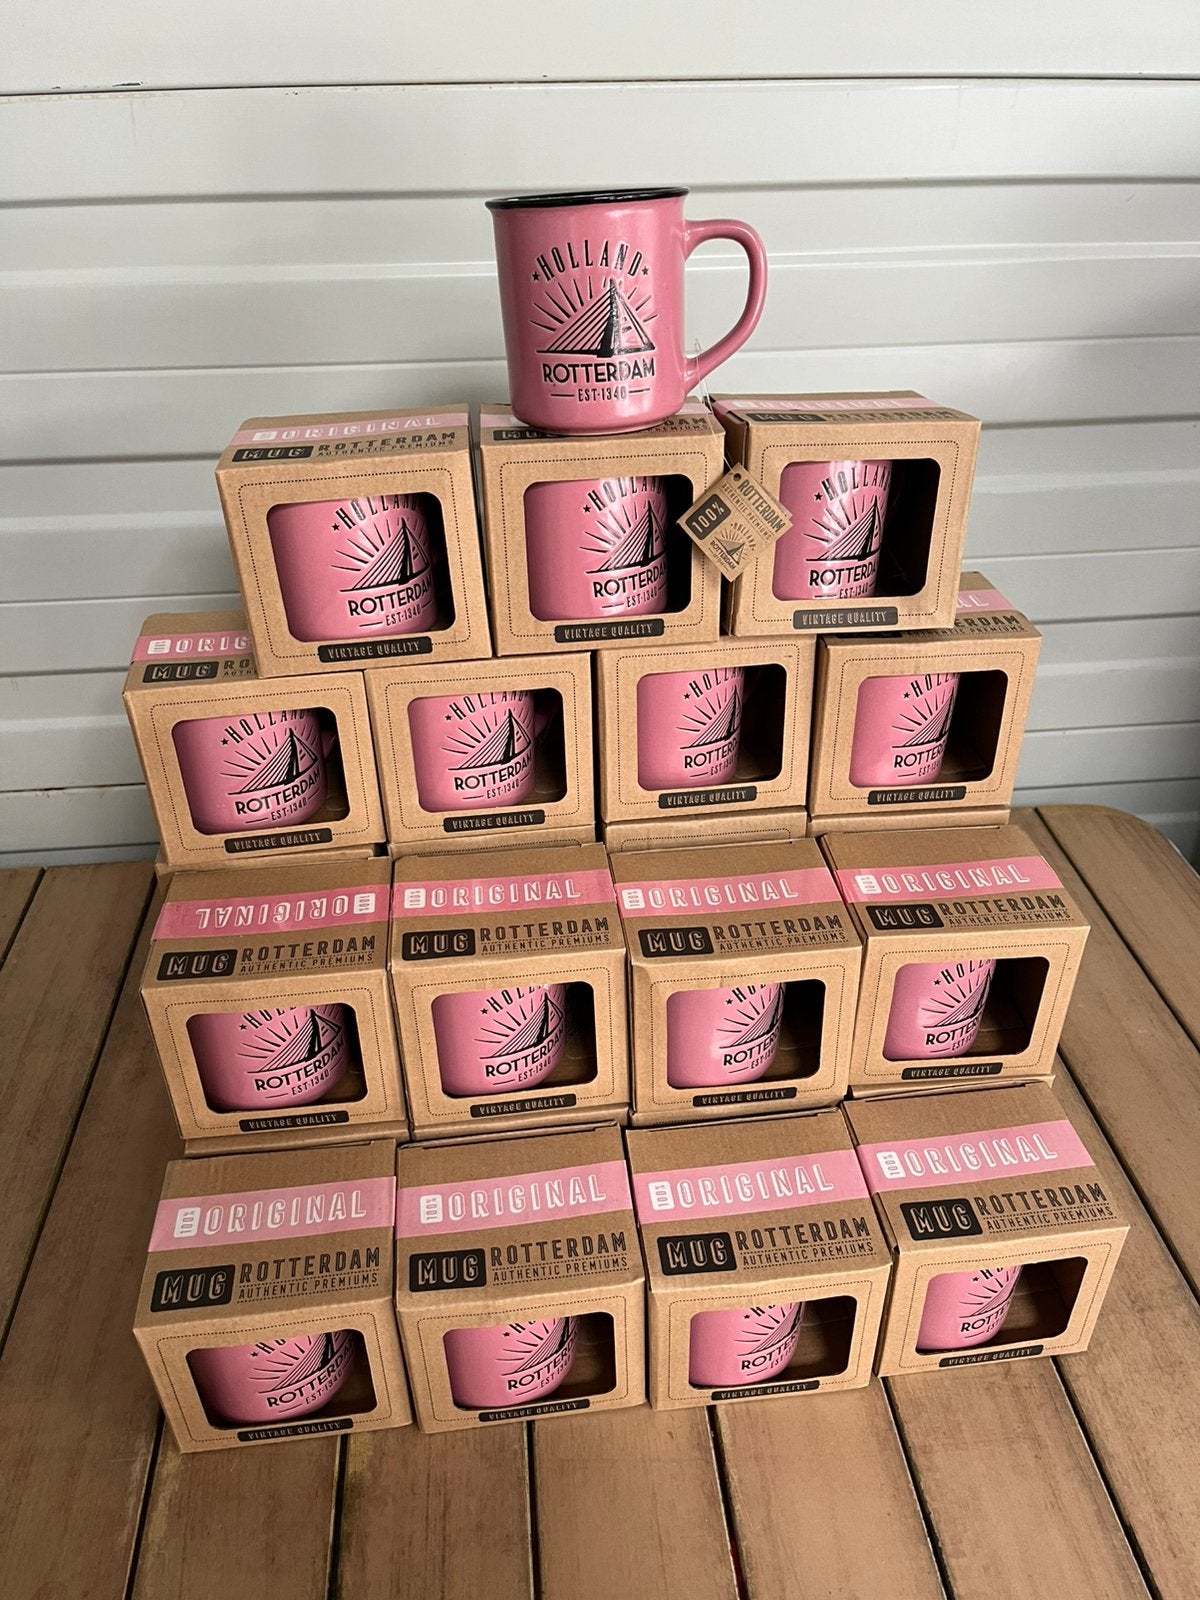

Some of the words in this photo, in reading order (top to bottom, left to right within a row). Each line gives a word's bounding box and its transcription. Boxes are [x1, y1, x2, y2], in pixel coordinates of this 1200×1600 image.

[536, 240, 643, 282] HOLLAND
[543, 358, 655, 382] ROTTERDAM
[282, 416, 441, 440] ORIGINAL
[242, 448, 305, 460] MUG
[318, 432, 456, 451] ROTTERDAM
[722, 483, 748, 512] AUTHENTIC
[738, 480, 785, 533] ROTTERDAM
[692, 501, 724, 533] 100%
[710, 540, 736, 570] ROTTERDAM
[564, 626, 607, 639] VINTAGE
[611, 624, 653, 636] QUALITY
[802, 613, 843, 625] VINTAGE
[847, 611, 887, 623] QUALITY
[328, 644, 373, 659] VINTAGE
[377, 641, 420, 656] QUALITY
[152, 665, 211, 679] MUG
[235, 769, 321, 816] ROTTERDAM
[667, 795, 706, 805] VINTAGE
[709, 791, 746, 801] QUALITY
[877, 792, 915, 802] VINTAGE
[919, 790, 955, 800] QUALITY
[452, 817, 493, 829] VINTAGE
[496, 814, 534, 825] QUALITY
[234, 835, 278, 850] VINTAGE
[281, 832, 321, 845] QUALITY
[648, 878, 799, 908] ORIGINAL
[881, 864, 1030, 894] ORIGINAL
[431, 879, 581, 908] ORIGINAL
[195, 895, 350, 929] ORIGINAL
[875, 907, 936, 927] MUG
[938, 894, 1066, 916] ROTTERDAM
[948, 913, 1010, 925] AUTHENTIC
[1013, 910, 1071, 921] PREMIUMS
[411, 933, 469, 955] MUG
[480, 917, 609, 942] ROTTERDAM
[482, 940, 546, 953] AUTHENTIC
[551, 934, 610, 946] PREMIUMS
[647, 931, 706, 952] MUG
[713, 915, 842, 940] ROTTERDAM
[719, 939, 783, 951] AUTHENTIC
[786, 932, 846, 944] PREMIUMS
[167, 953, 230, 975] MUG
[242, 935, 376, 962] ROTTERDAM
[241, 959, 307, 973] AUTHENTIC
[312, 953, 373, 967] PREMIUMS
[953, 1066, 992, 1075] QUALITY
[479, 1104, 521, 1115] VINTAGE
[525, 1099, 564, 1110] QUALITY
[702, 1095, 743, 1105] VINTAGE
[746, 1091, 786, 1100] QUALITY
[248, 1118, 292, 1129] VINTAGE
[296, 1114, 337, 1125] QUALITY
[903, 1133, 1058, 1177] ORIGINAL
[448, 1174, 606, 1222] ORIGINAL
[676, 1164, 834, 1208] ORIGINAL
[204, 1190, 367, 1236] ORIGINAL
[910, 1203, 972, 1234] MUG
[974, 1183, 1107, 1216] ROTTERDAM
[987, 1212, 1051, 1230] AUTHENTIC
[1054, 1206, 1114, 1223] PREMIUMS
[666, 1238, 728, 1269] MUG
[735, 1217, 870, 1251] ROTTERDAM
[743, 1248, 808, 1267] AUTHENTIC
[813, 1241, 874, 1259] PREMIUMS
[418, 1255, 479, 1285] MUG
[491, 1231, 627, 1267] ROTTERDAM
[493, 1265, 560, 1282] AUTHENTIC
[566, 1257, 628, 1274] PREMIUMS
[160, 1271, 226, 1305] MUG
[240, 1247, 380, 1283] ROTTERDAM
[239, 1280, 308, 1300] AUTHENTIC
[314, 1272, 378, 1290] PREMIUMS
